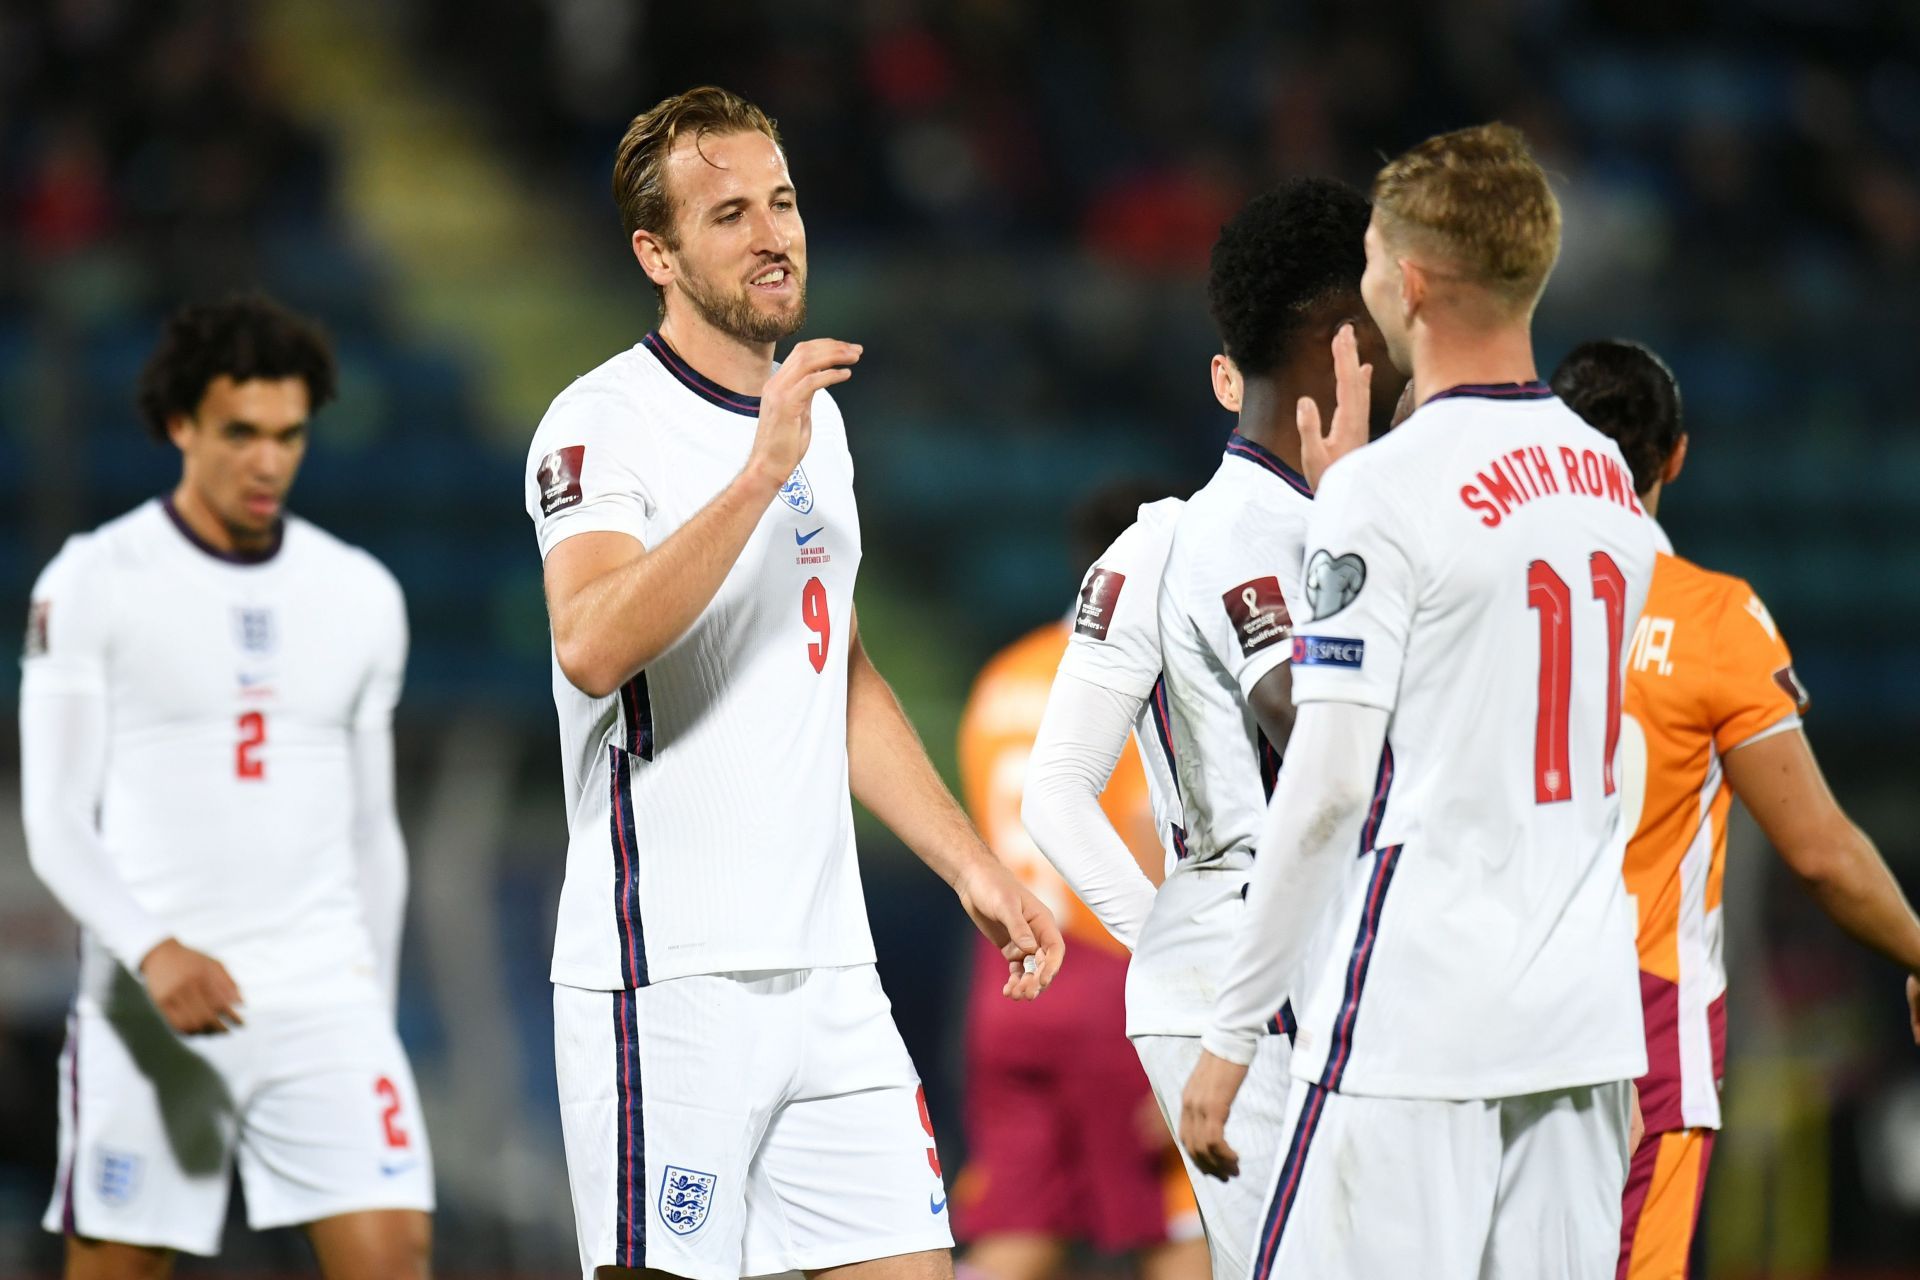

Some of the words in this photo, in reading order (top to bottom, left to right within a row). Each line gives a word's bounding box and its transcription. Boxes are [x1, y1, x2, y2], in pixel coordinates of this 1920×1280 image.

[1460, 446, 1559, 528] SMITH
[802, 576, 830, 674] 9
[1247, 625, 1284, 647] Qualifiers
[1527, 551, 1626, 805] 11
[236, 711, 266, 779] 2
[375, 1077, 408, 1147] 2
